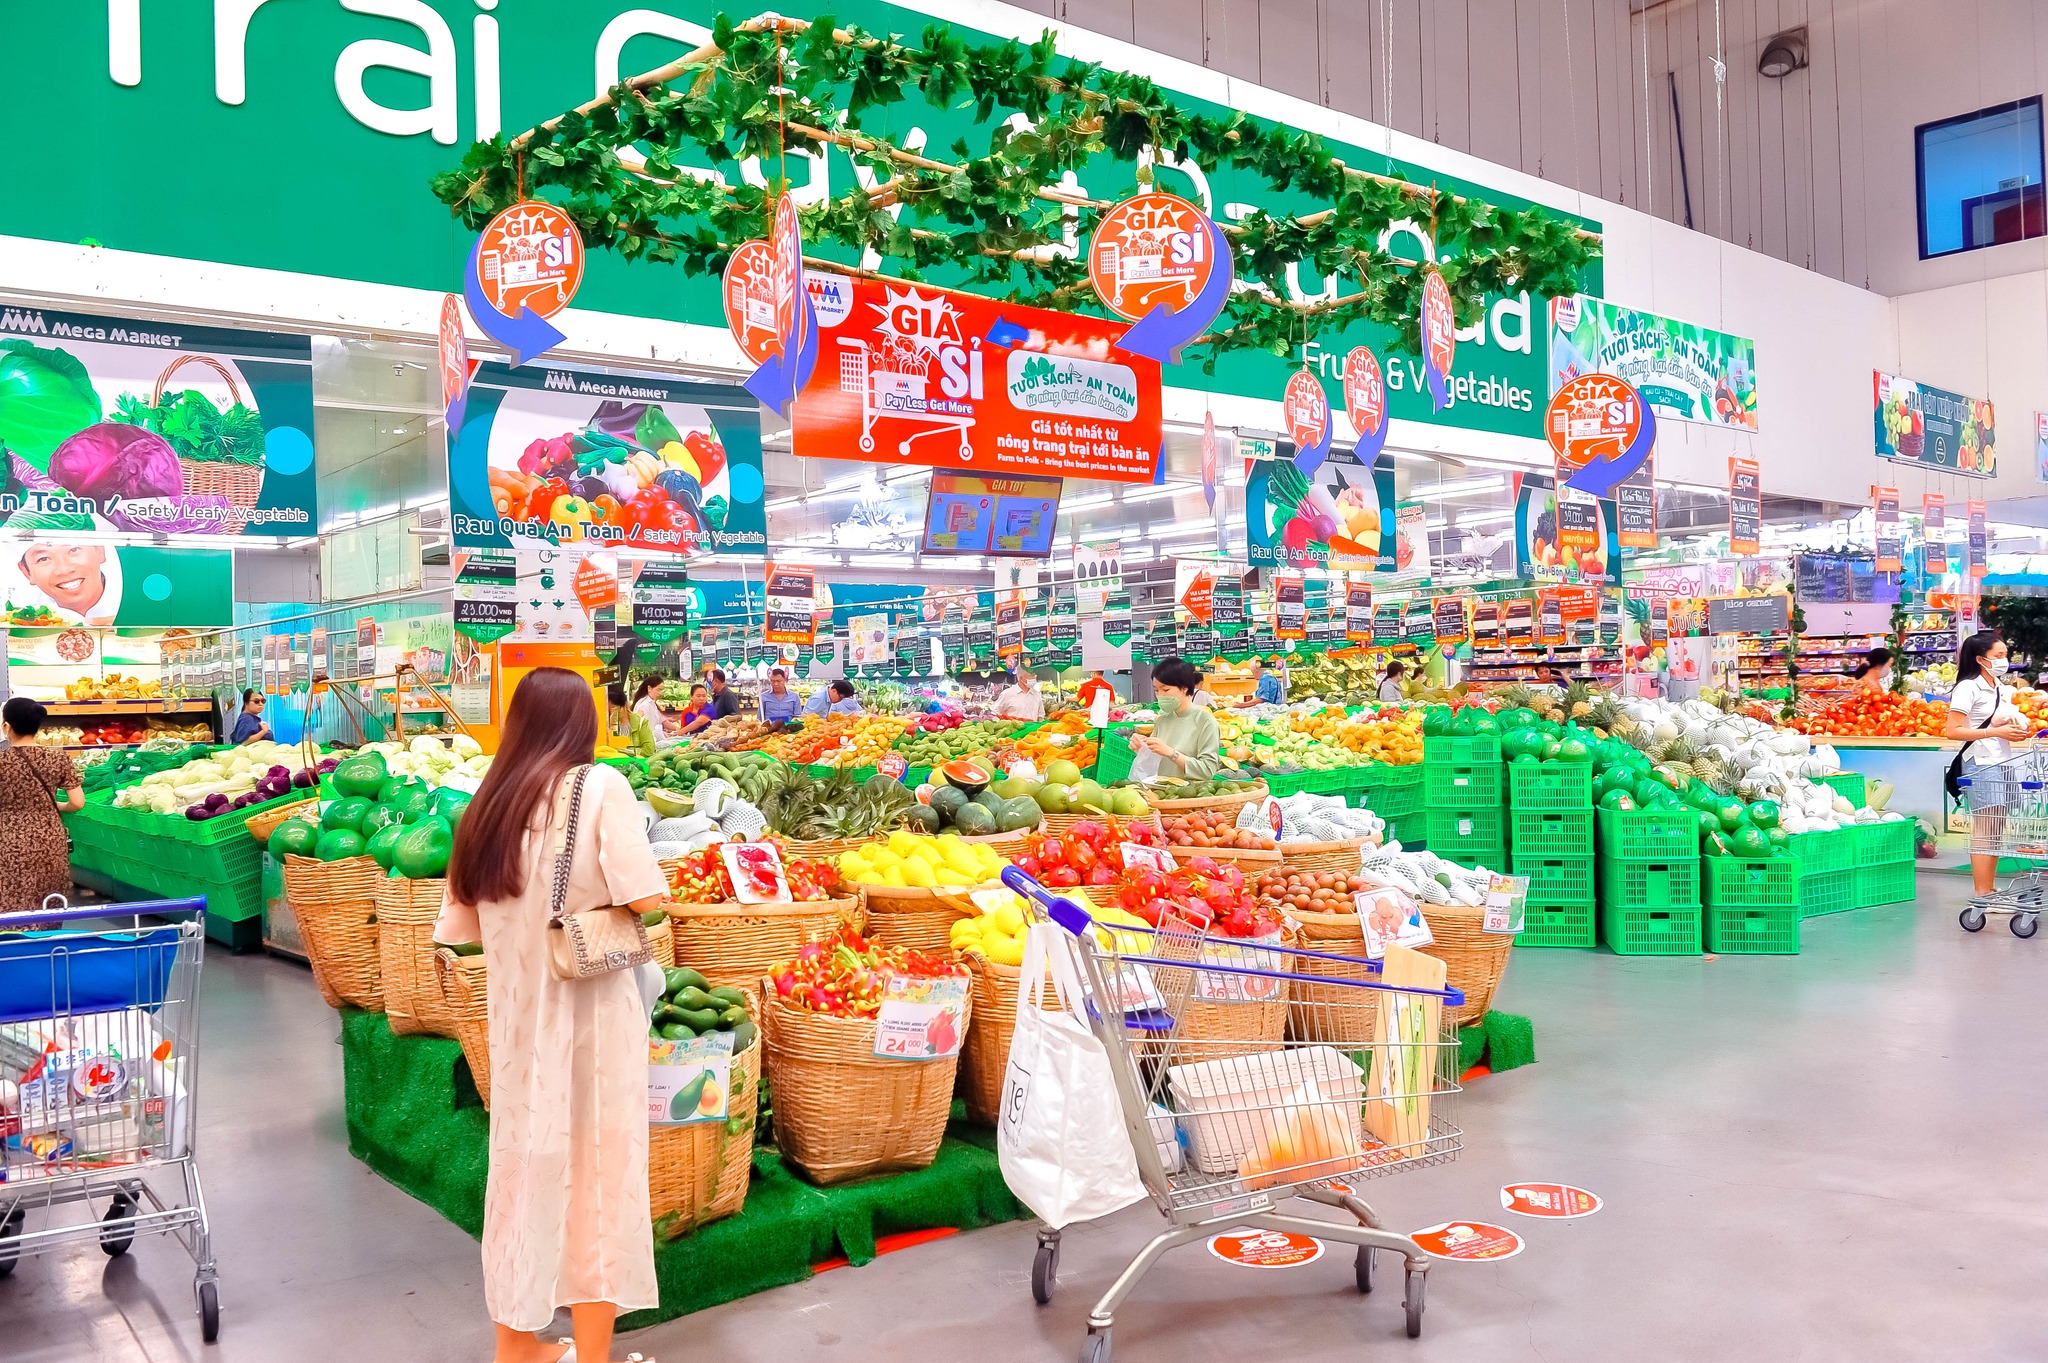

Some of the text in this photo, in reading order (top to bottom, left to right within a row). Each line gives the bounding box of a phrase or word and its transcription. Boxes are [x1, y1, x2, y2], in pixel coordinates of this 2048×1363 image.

[750, 254, 772, 278] GI
[1163, 266, 1195, 275] Get More
[51, 322, 183, 348] Mega Market
[1673, 340, 1689, 359] AN
[579, 382, 669, 400] Mega Market
[1086, 377, 1103, 391] AN
[1106, 382, 1136, 407] TOÀN
[1387, 358, 1405, 391] &
[1409, 359, 1533, 413] Vgetables
[885, 393, 974, 415] Pay Less Get More
[1031, 420, 1052, 435] Giá
[1054, 420, 1073, 437] tốt
[1075, 424, 1103, 440] nhất
[997, 433, 1030, 453] nông
[1032, 438, 1066, 456] trang
[1068, 441, 1090, 459] trại
[1111, 445, 1134, 460] bàn
[1136, 447, 1150, 461] ăn
[1240, 448, 1254, 456] EXIT
[997, 453, 1016, 463] Farm
[1016, 455, 1024, 463] to
[1025, 456, 1040, 465] Folk
[1044, 458, 1063, 468] Bring
[1063, 459, 1075, 468] the
[1075, 460, 1090, 469] best
[1090, 461, 1110, 471] prices
[1109, 462, 1117, 471] in
[1117, 463, 1128, 472] the
[1128, 464, 1151, 474] market
[29, 491, 96, 514] Toàn
[104, 495, 122, 516] /
[127, 503, 180, 522] Safety
[184, 505, 231, 525] Leafy
[233, 507, 310, 524] Vegetable
[453, 513, 766, 546] Rau Quả An Toàn / Safety Fruit Vegetable
[1252, 545, 1272, 559] Rau
[1290, 548, 1304, 560] An
[1306, 549, 1330, 561] Toàn
[1663, 578, 1701, 598] Cây
[461, 603, 498, 617] 23.000
[1669, 611, 1708, 633] JUICE
[1489, 917, 1502, 928] 59
[885, 1038, 906, 1053] 24
[145, 1101, 164, 1113] Gft
[1261, 1254, 1305, 1265] MCARD
